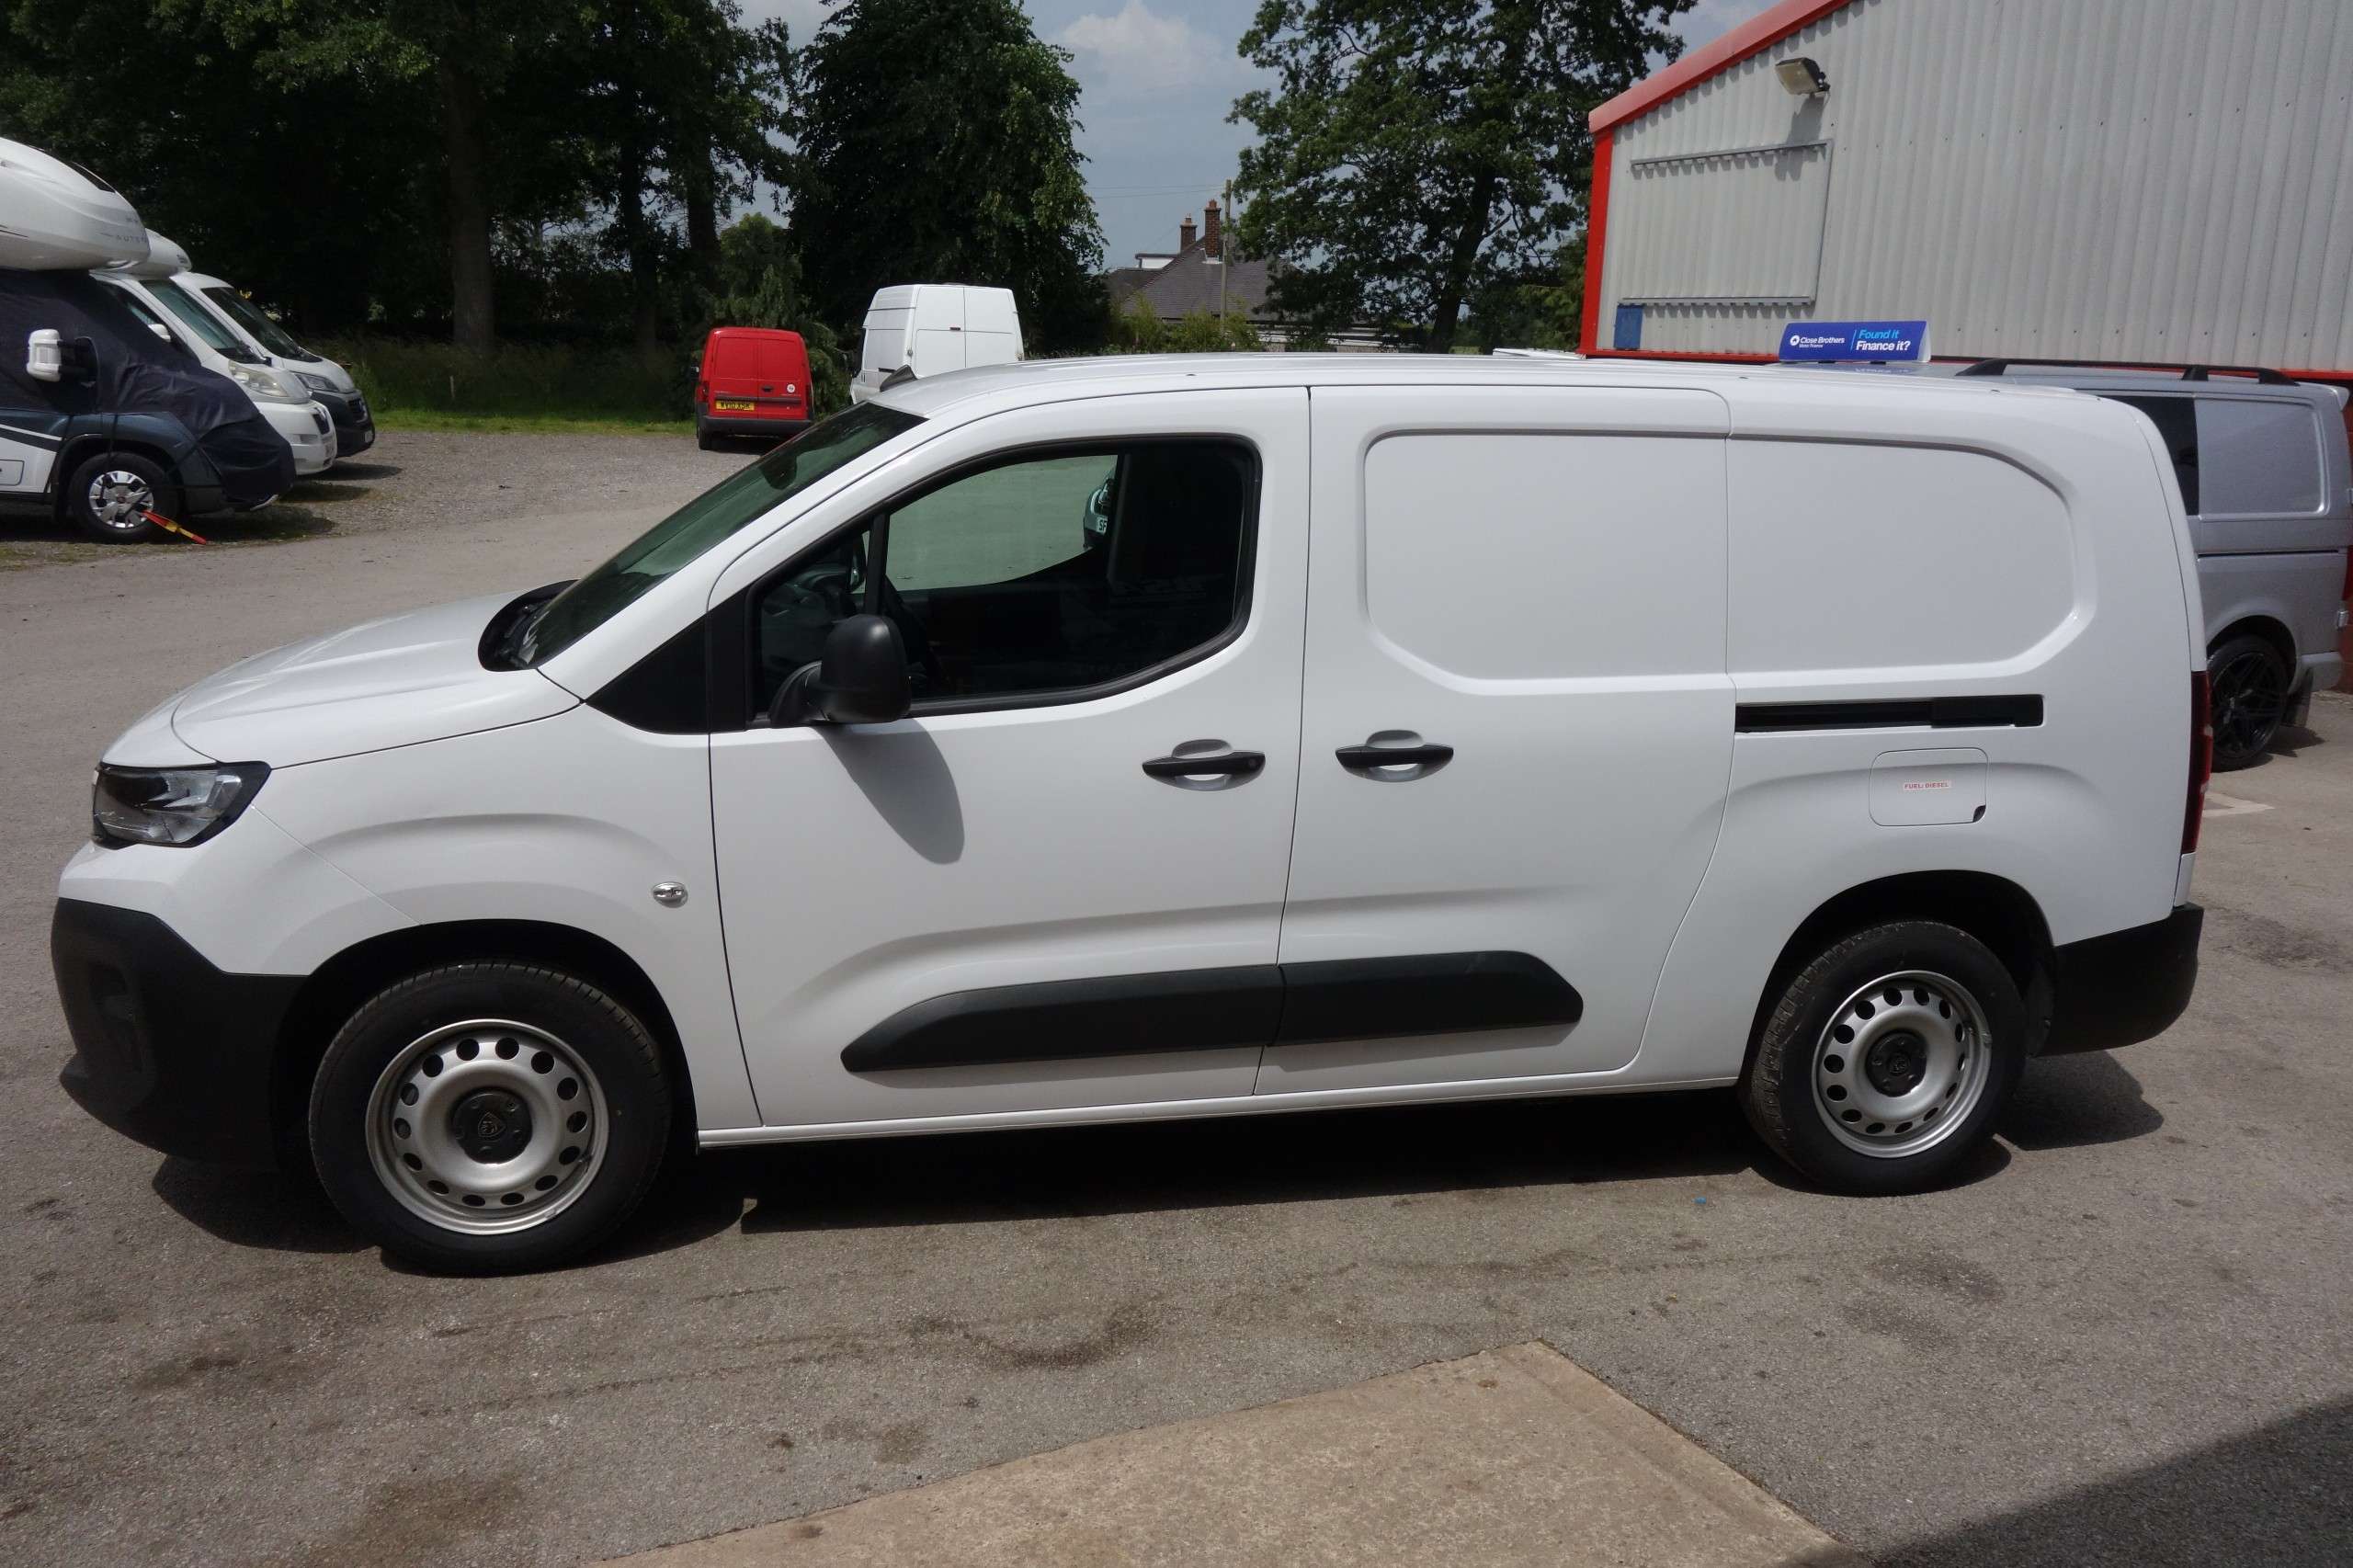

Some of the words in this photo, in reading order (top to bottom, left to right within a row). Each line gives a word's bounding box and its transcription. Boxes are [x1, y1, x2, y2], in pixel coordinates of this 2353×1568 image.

[1859, 329, 1890, 339] Found
[1891, 330, 1900, 339] it
[1856, 340, 1894, 351] Finance
[1895, 340, 1911, 351] it?
